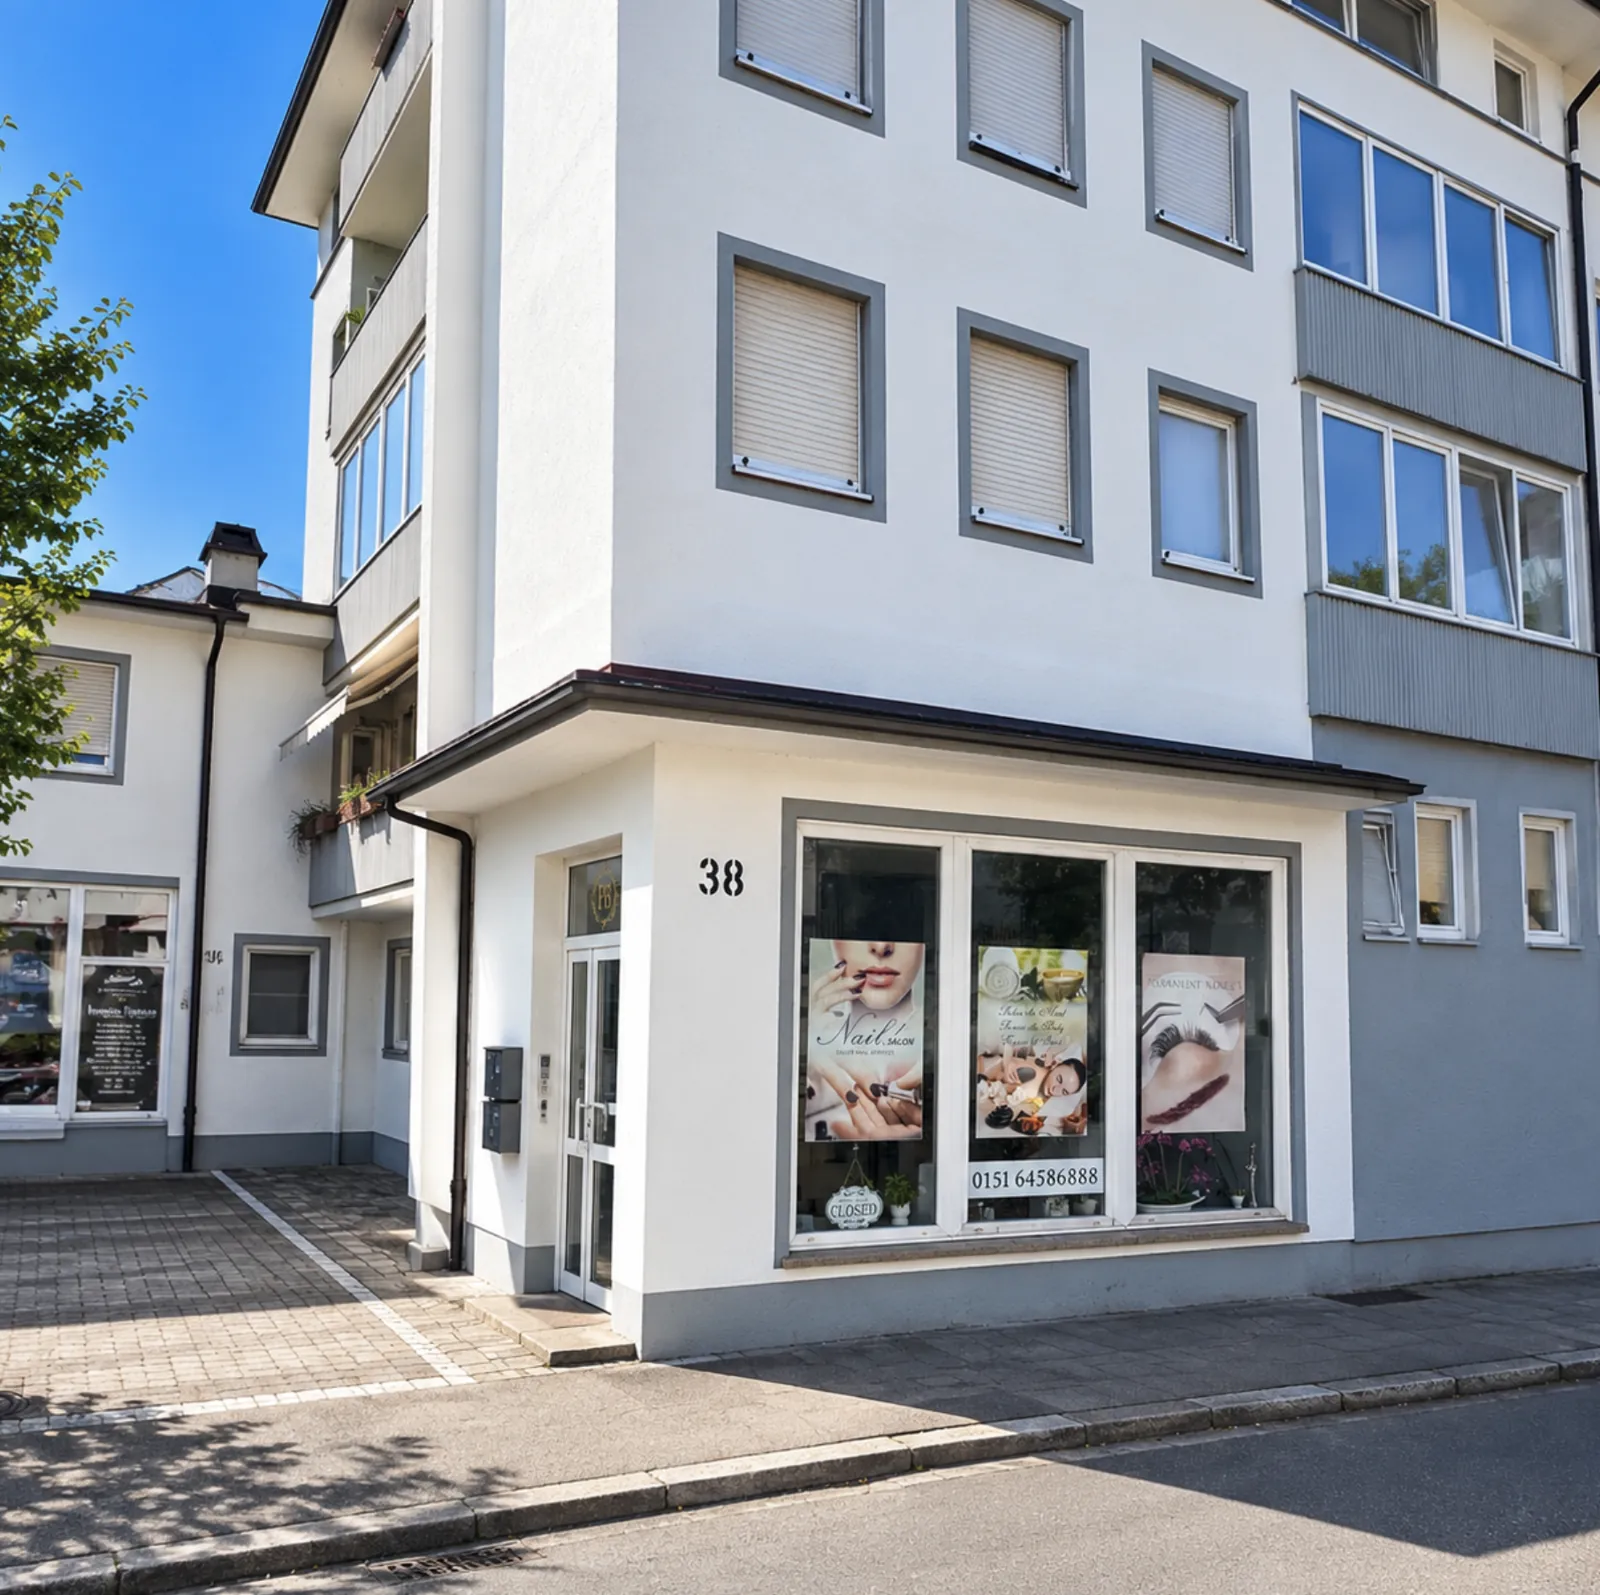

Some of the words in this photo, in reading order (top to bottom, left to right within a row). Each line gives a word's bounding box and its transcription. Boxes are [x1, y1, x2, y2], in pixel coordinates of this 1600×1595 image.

[699, 857, 744, 897] 38
[972, 1171, 1009, 1189] 0151
[1015, 1167, 1098, 1187] 64586888
[831, 1203, 877, 1218] CLOSED
